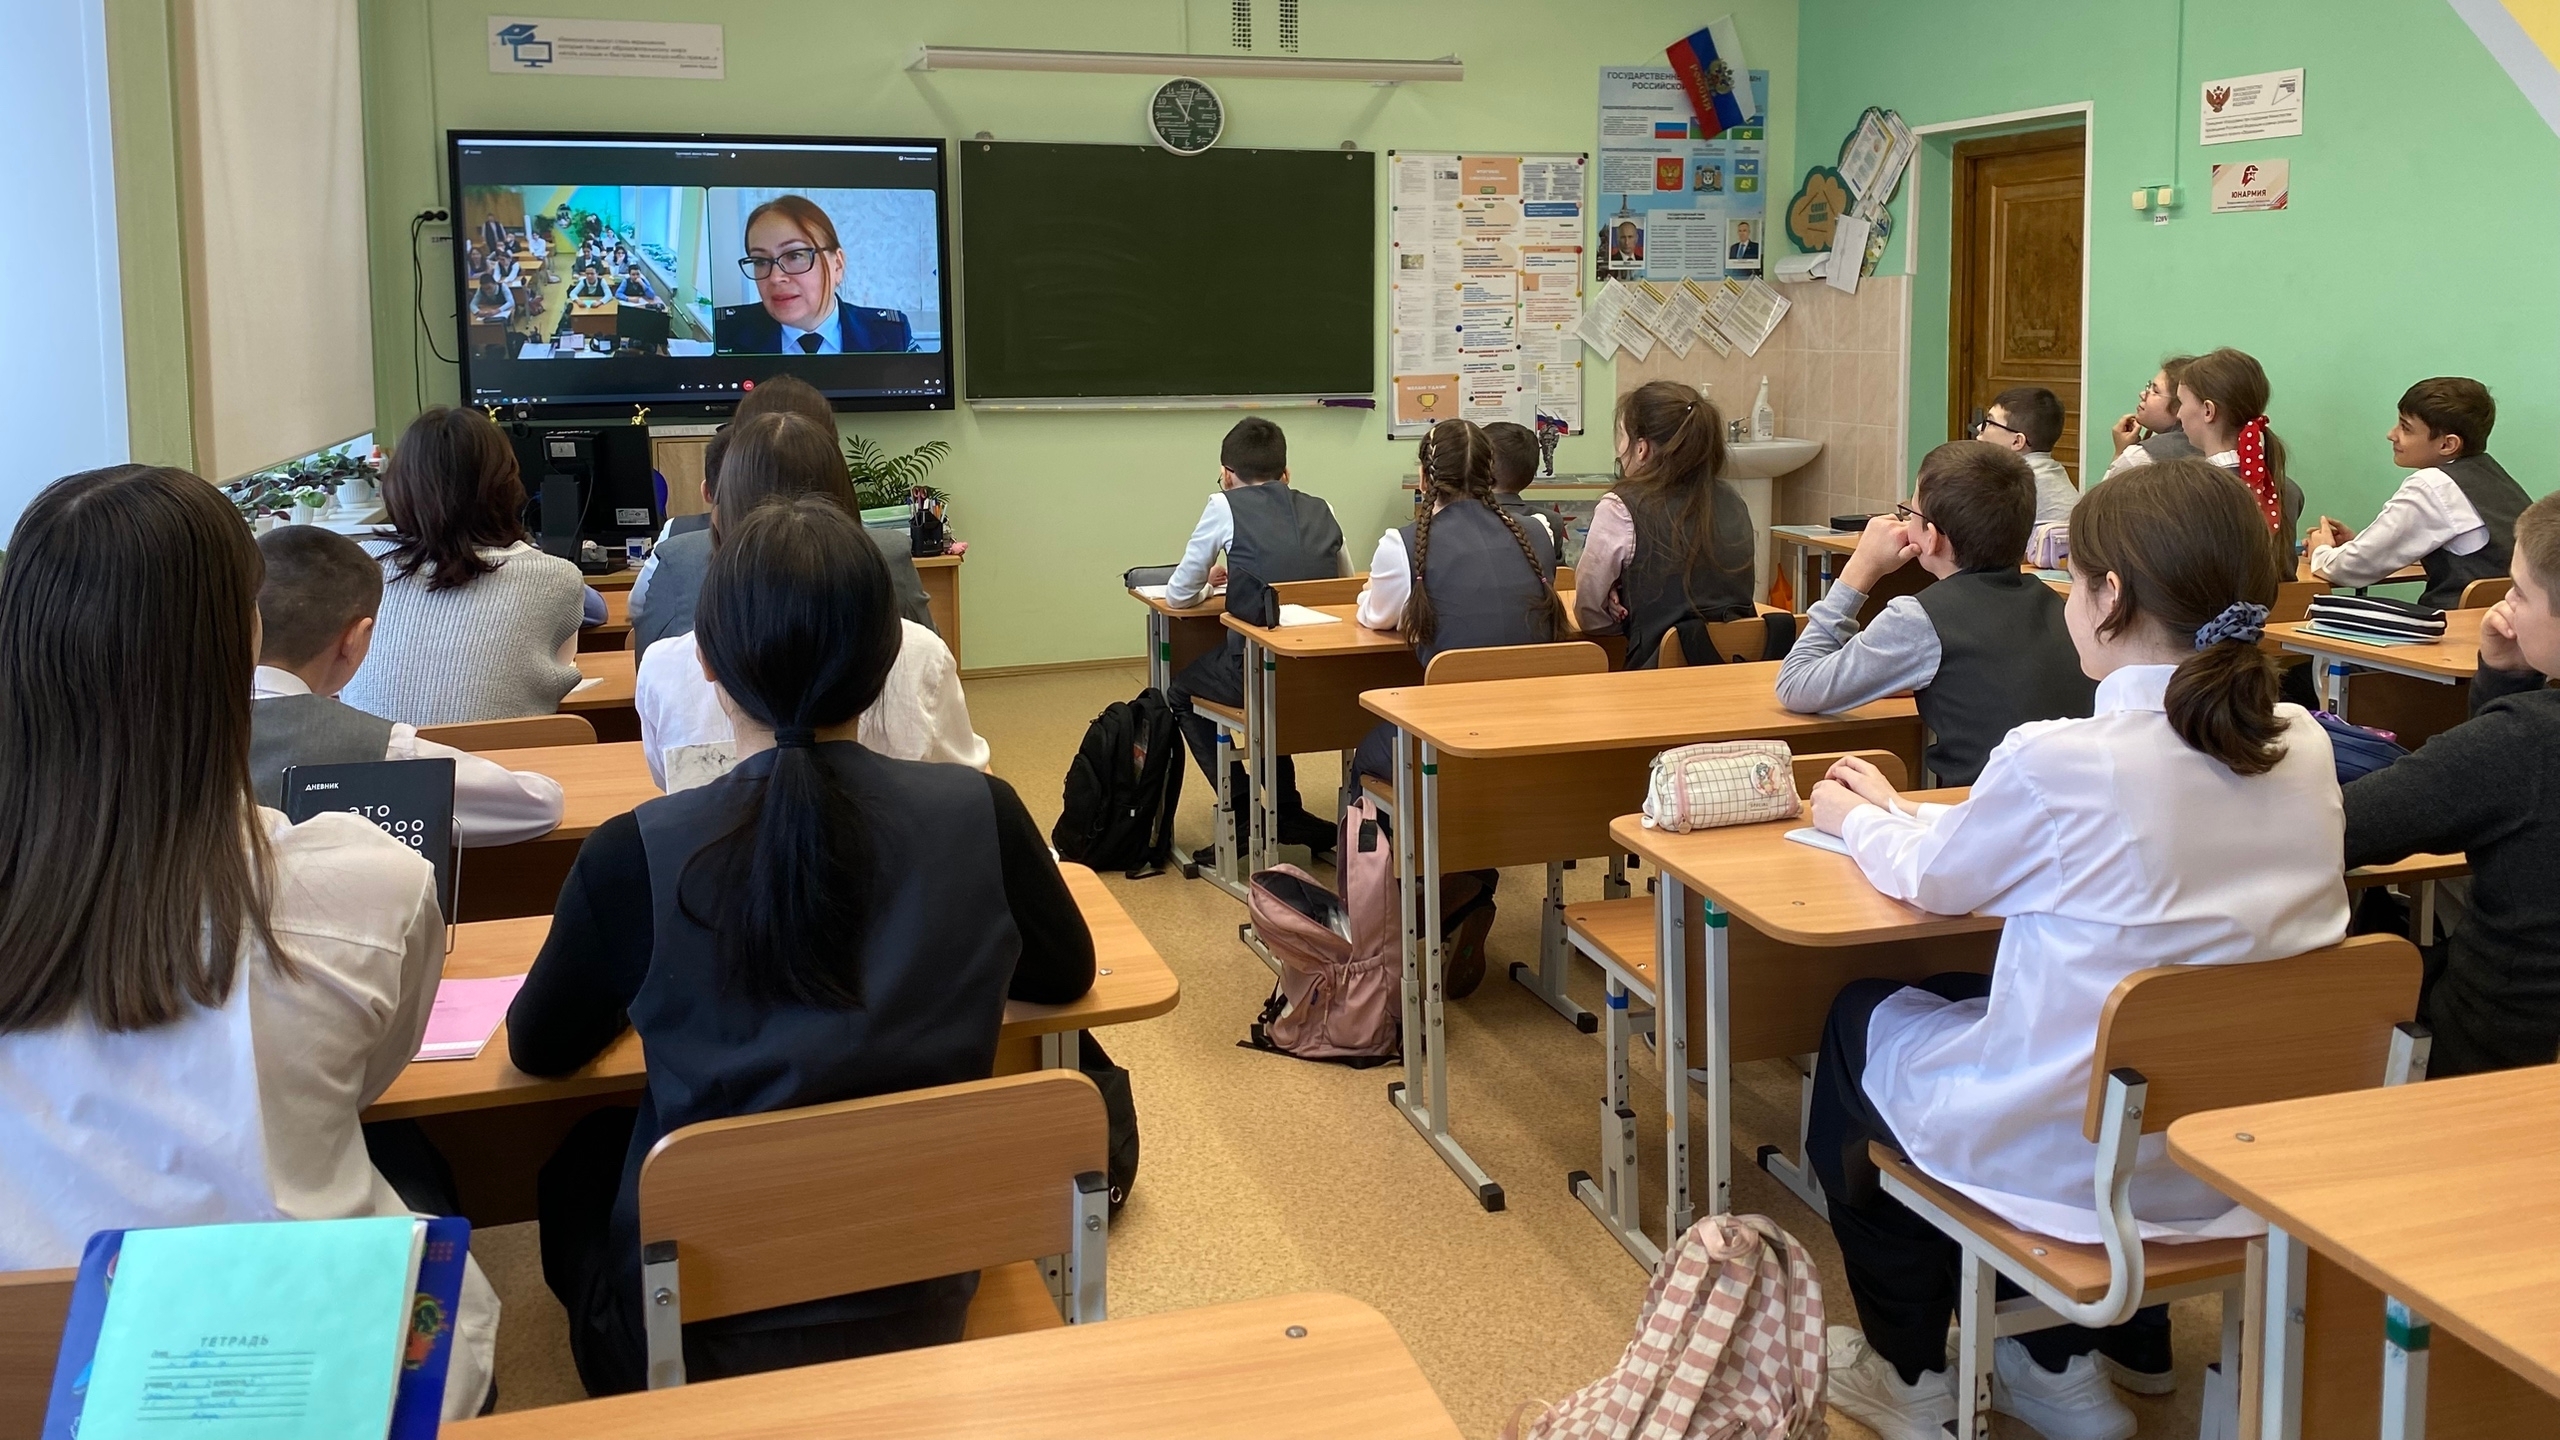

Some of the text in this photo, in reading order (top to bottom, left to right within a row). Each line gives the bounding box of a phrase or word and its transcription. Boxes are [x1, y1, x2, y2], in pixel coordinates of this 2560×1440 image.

[1689, 63, 1712, 111] РОССИЯ
[2231, 189, 2267, 198] ЮНАРМИЯ
[304, 782, 339, 791] ДНЕВНИК
[349, 805, 390, 817] ЭТО
[200, 1334, 269, 1347] ТЕТРАДЬ
